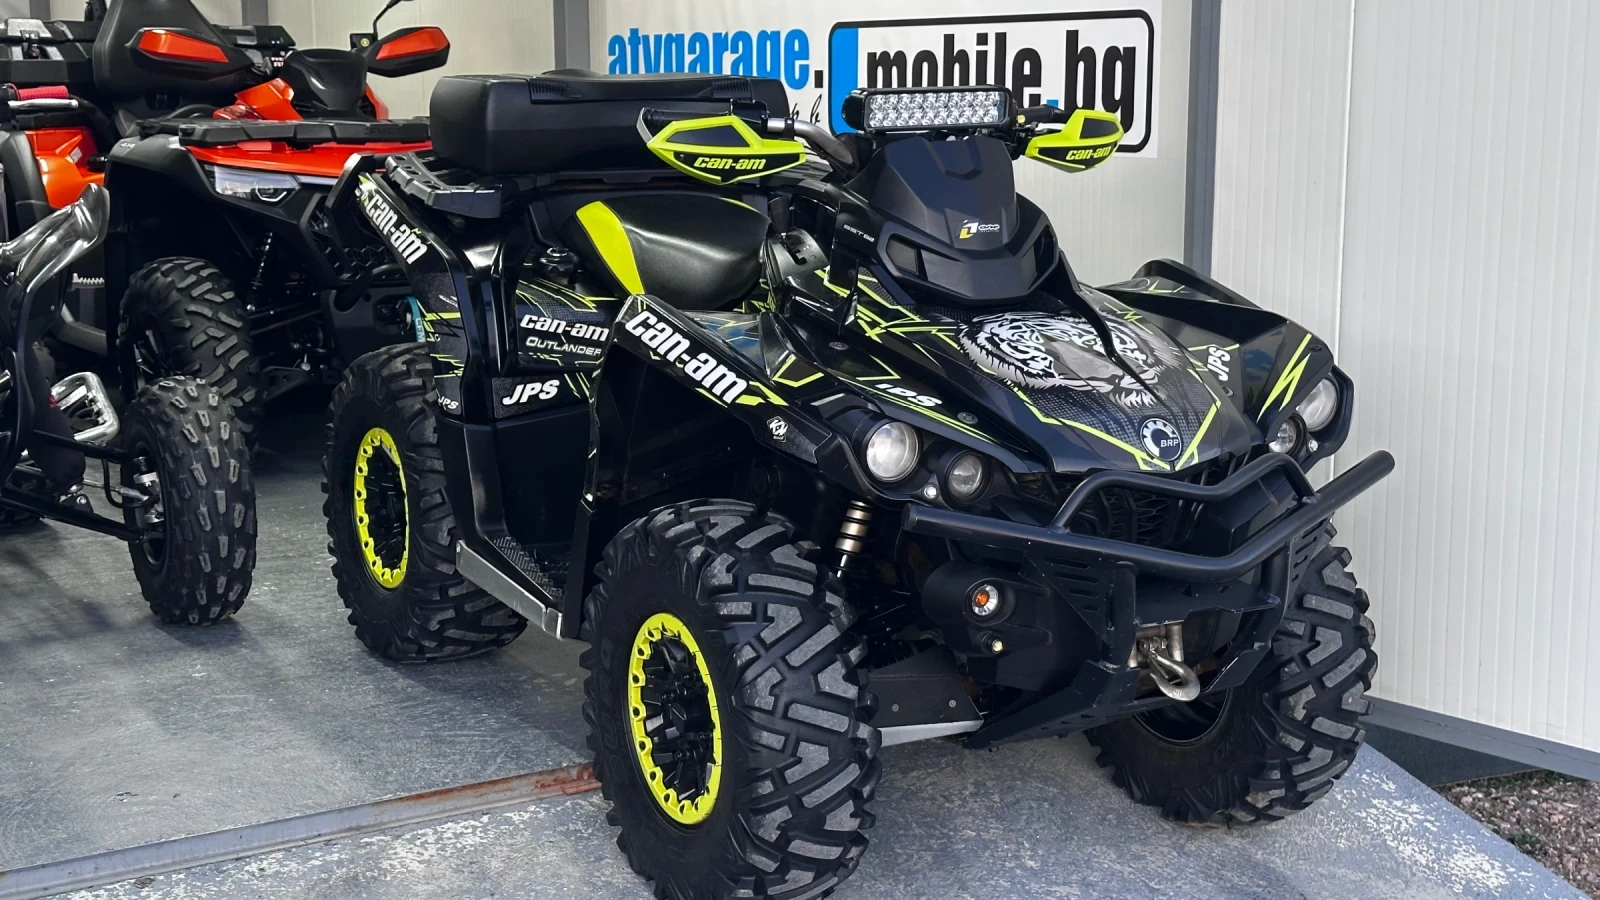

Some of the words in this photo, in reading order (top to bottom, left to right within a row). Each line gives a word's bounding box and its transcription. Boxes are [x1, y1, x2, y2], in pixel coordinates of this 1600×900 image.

[694, 155, 766, 170] can-am
[1065, 145, 1112, 161] can-am
[365, 193, 428, 265] can-am
[519, 313, 609, 342] can-am
[624, 310, 748, 404] can-am
[1207, 346, 1232, 382] JPS
[438, 395, 459, 410] JPS
[502, 379, 560, 406] JPS
[1160, 438, 1180, 449] BRP
